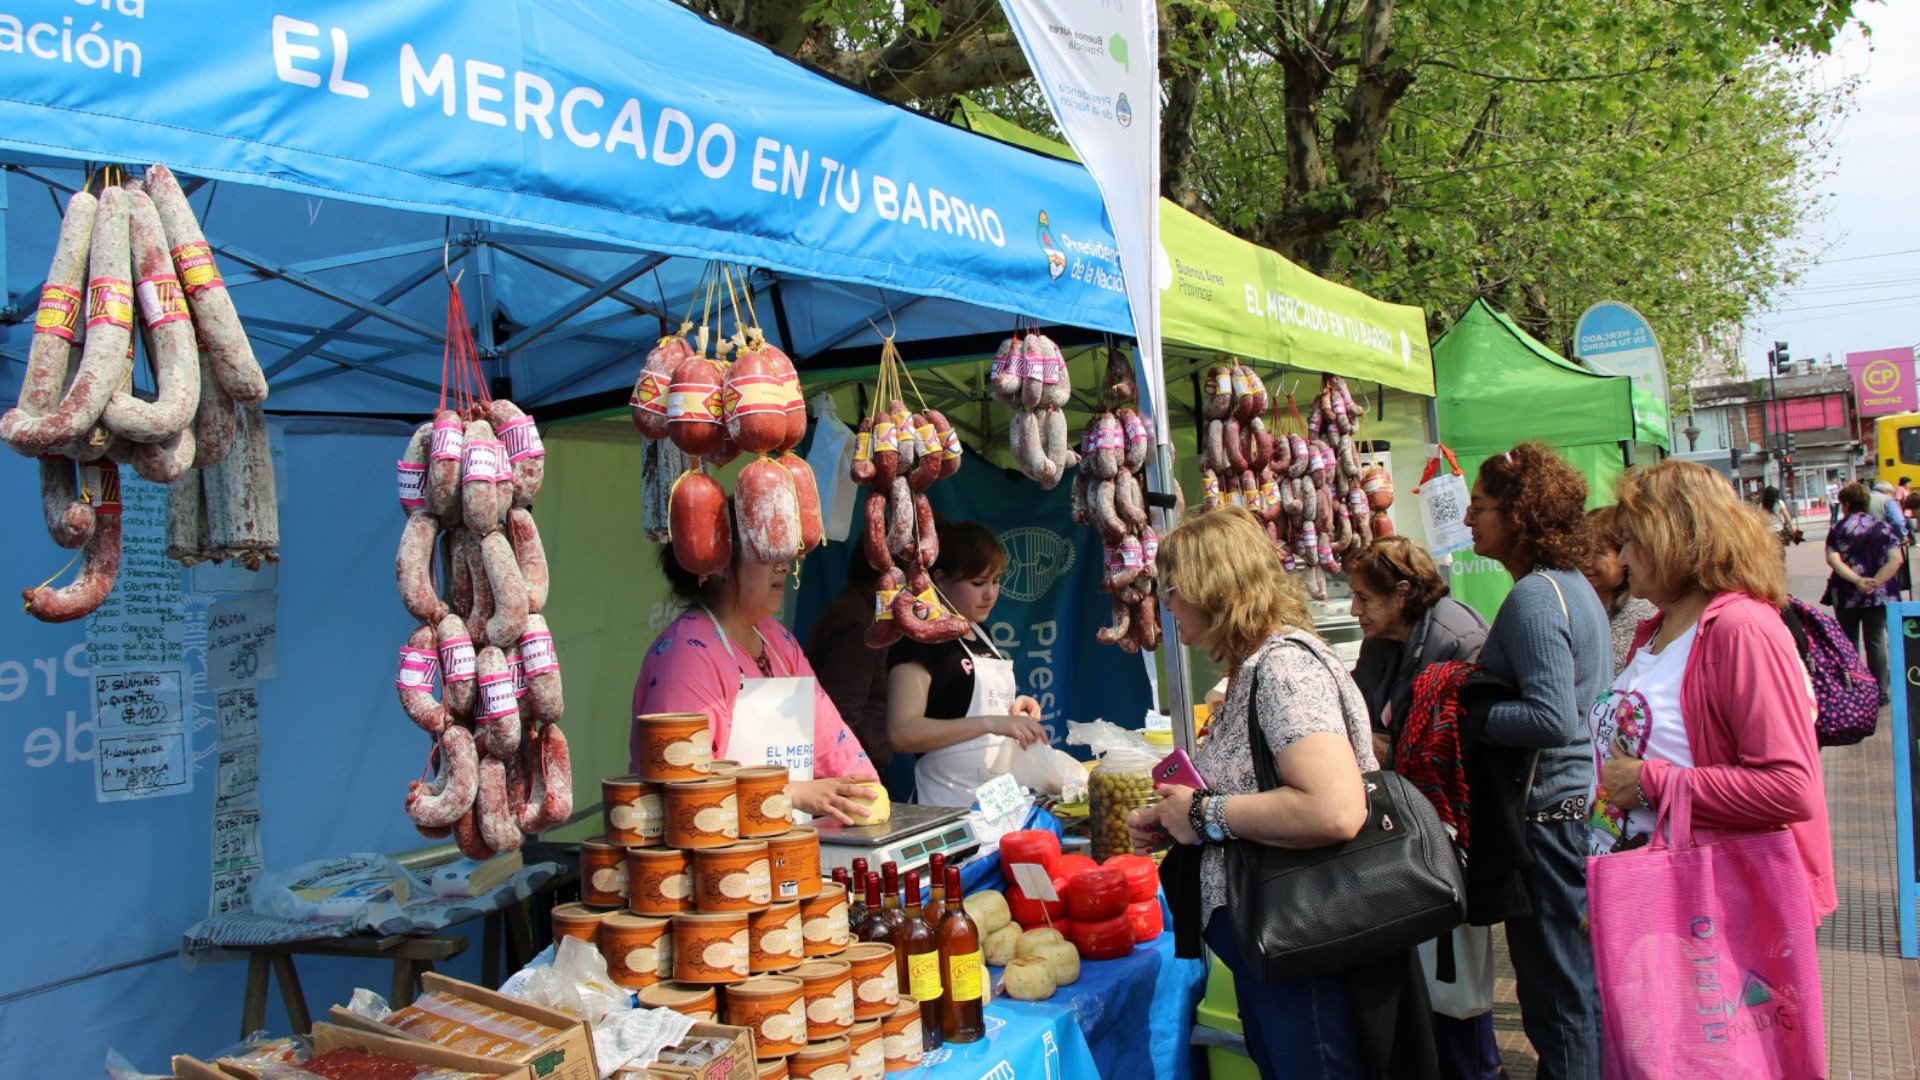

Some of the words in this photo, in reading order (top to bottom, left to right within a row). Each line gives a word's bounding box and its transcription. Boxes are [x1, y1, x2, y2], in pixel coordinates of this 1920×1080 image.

[272, 14, 370, 99] EL
[401, 43, 737, 179] MERCADO
[752, 136, 809, 200] EN
[818, 156, 861, 214] TU
[872, 175, 1005, 248] BARRIO
[1071, 257, 1084, 280] de
[1084, 261, 1093, 284] la
[1094, 266, 1125, 293] Nació
[1175, 258, 1206, 281] Buenos
[1179, 277, 1212, 301] Provincia
[1244, 282, 1264, 317] EL
[1266, 290, 1329, 334] MERCADO
[1328, 311, 1345, 338] EN
[1344, 316, 1359, 344] TU
[1359, 321, 1393, 356] BARRIO
[1869, 369, 1894, 385] CP
[767, 746, 781, 757] EL
[786, 759, 800, 769] TU
